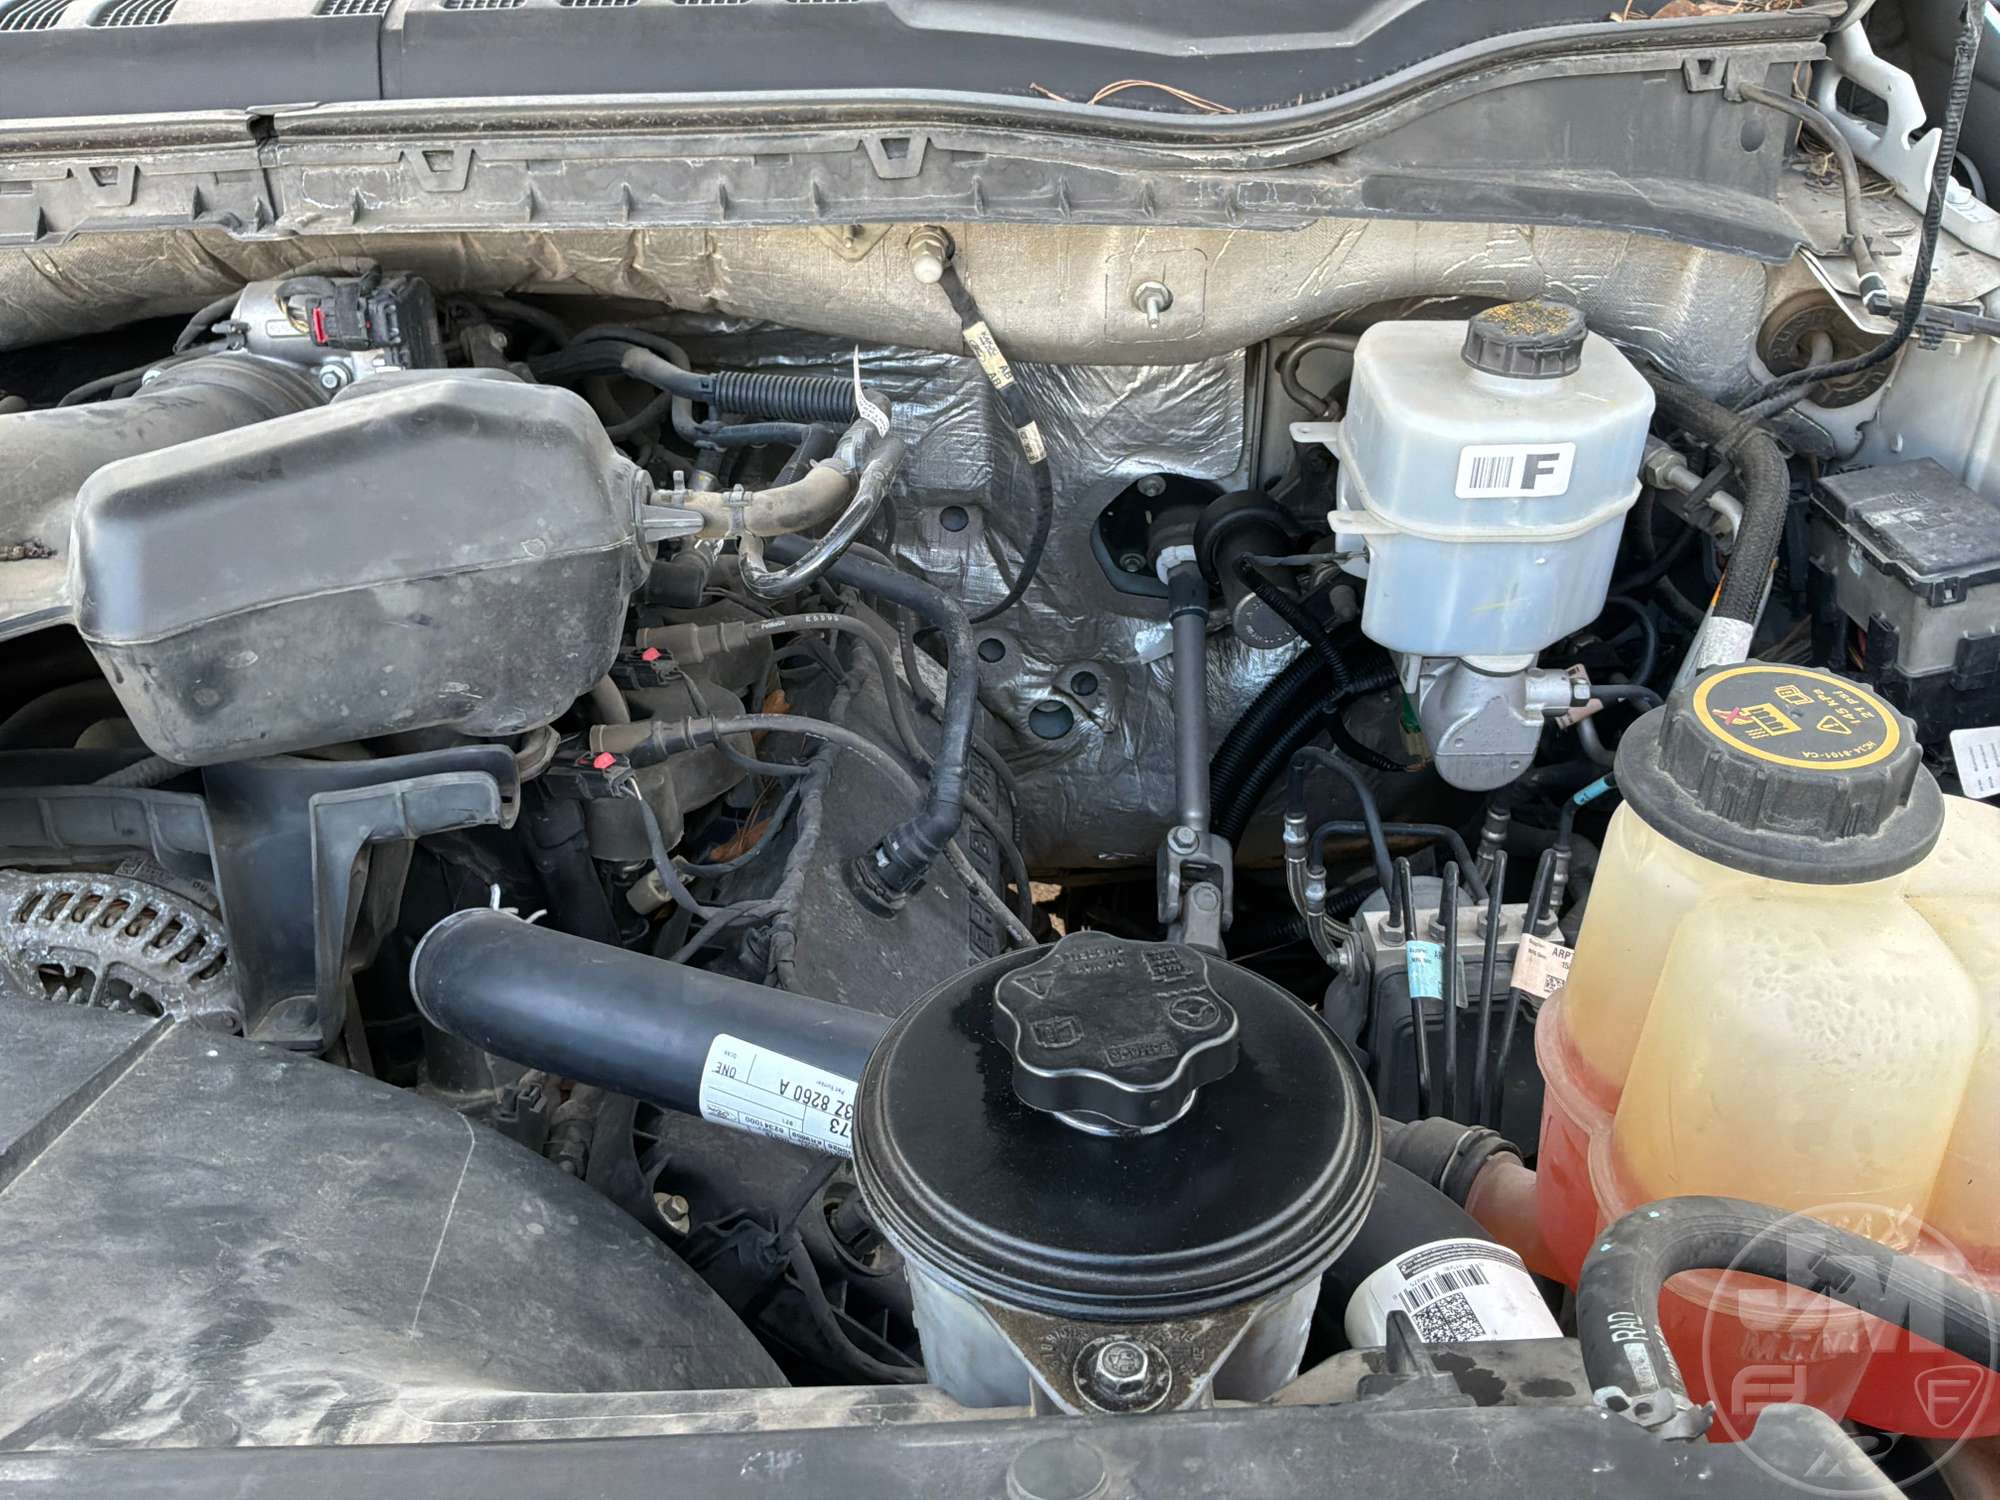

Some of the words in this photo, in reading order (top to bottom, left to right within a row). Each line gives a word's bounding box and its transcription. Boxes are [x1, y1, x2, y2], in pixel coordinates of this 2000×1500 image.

[988, 372, 1002, 386] AB
[1000, 365, 1013, 380] AB
[1520, 453, 1560, 489] F
[1832, 690, 1859, 705] psi
[1835, 708, 1861, 724] 145
[1854, 707, 1875, 719] 21
[1552, 947, 1575, 960] ARP
[716, 1062, 737, 1079] ONE
[779, 1079, 790, 1095] A
[794, 1085, 830, 1111] 8260
[1607, 1311, 1649, 1342] RAD
